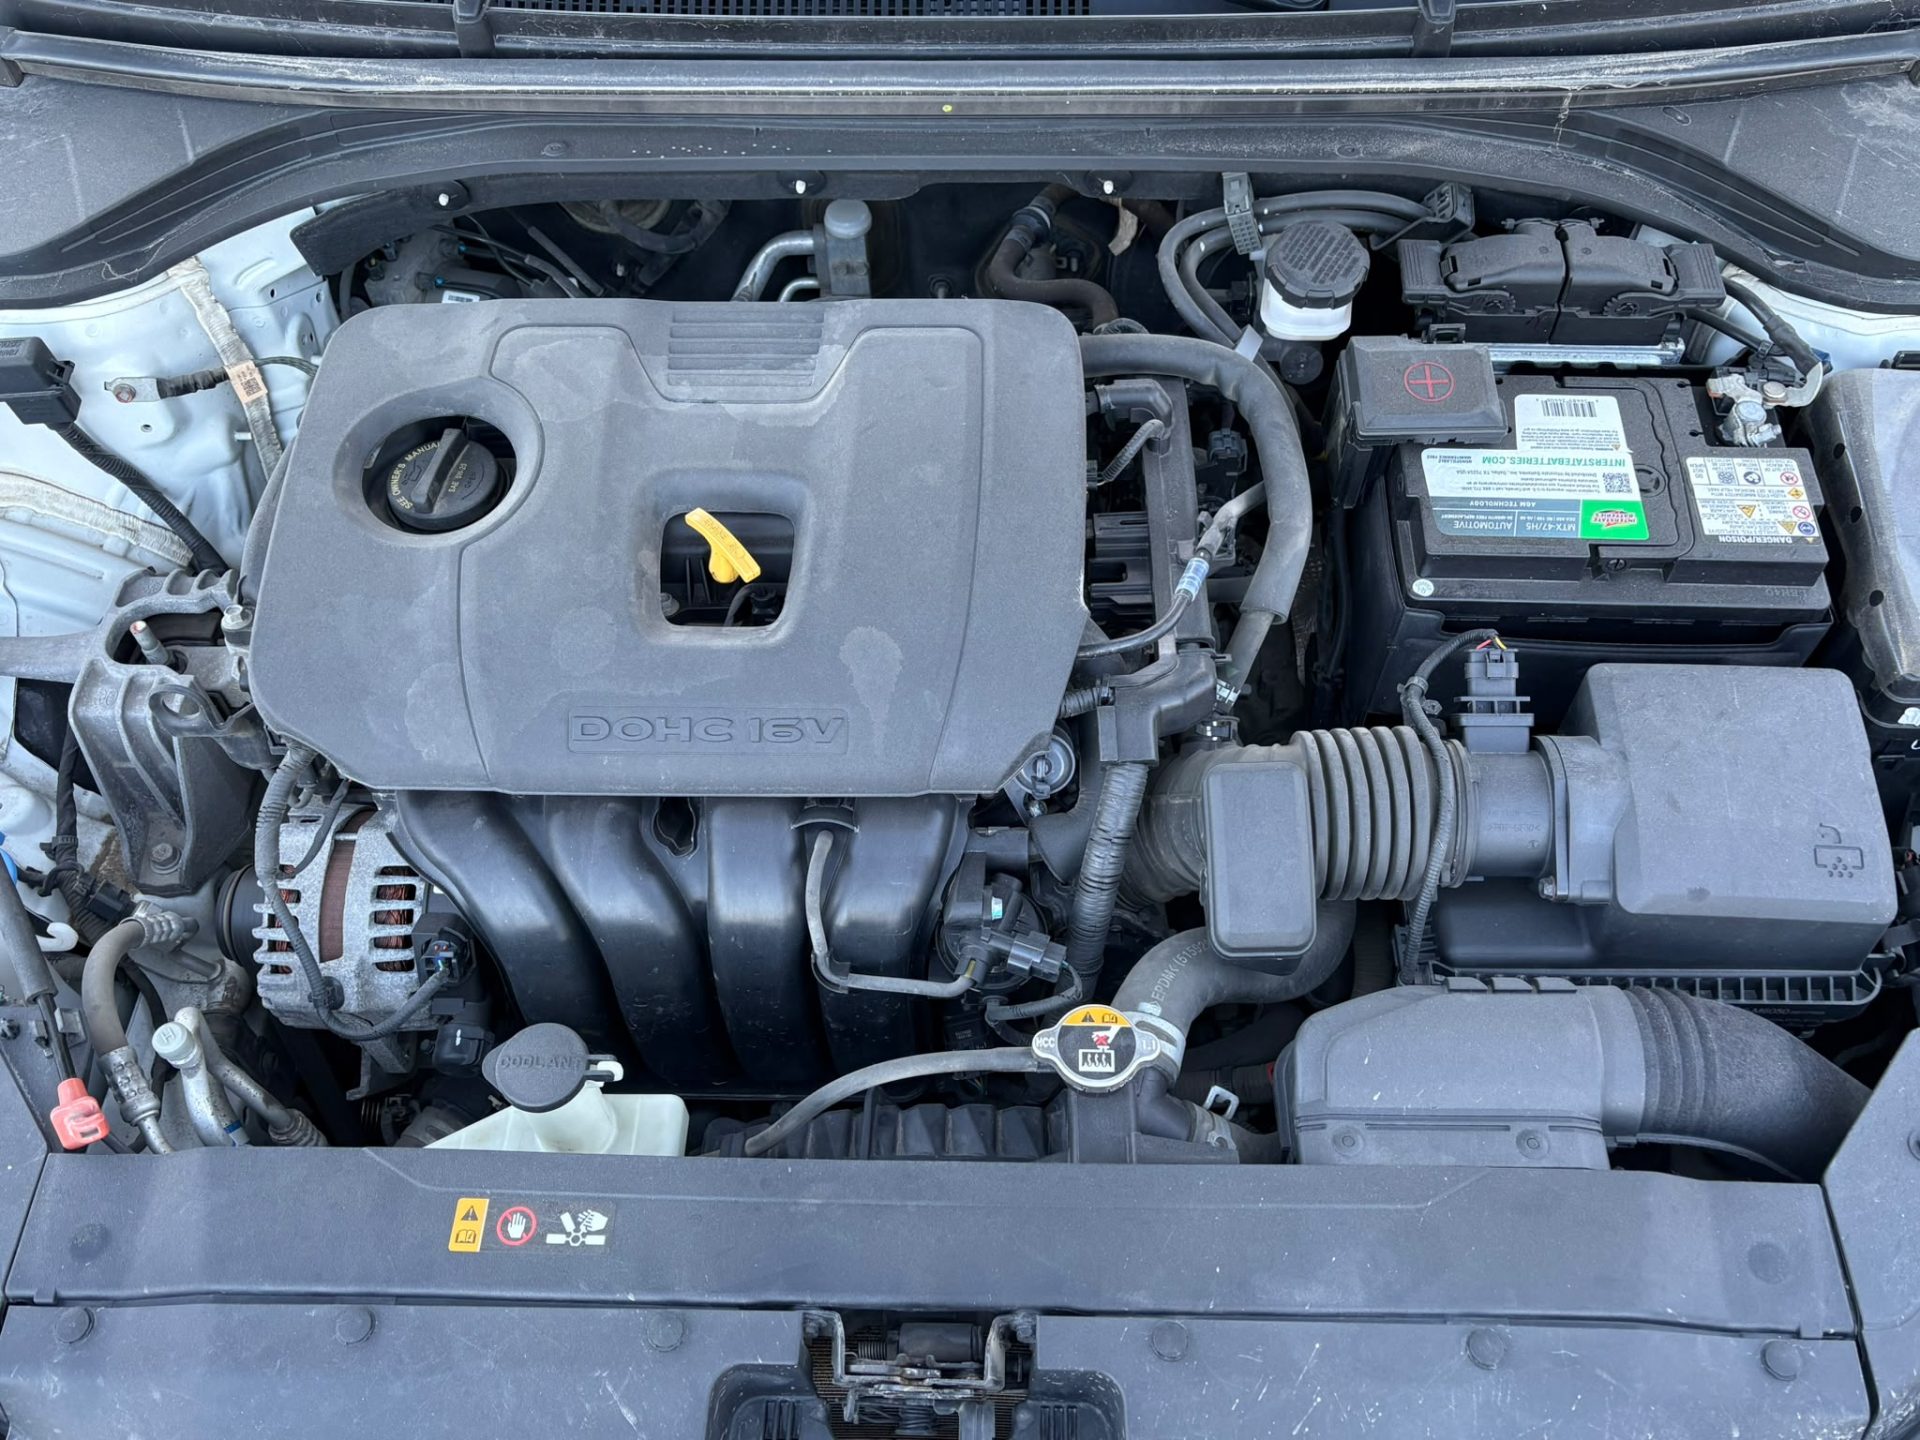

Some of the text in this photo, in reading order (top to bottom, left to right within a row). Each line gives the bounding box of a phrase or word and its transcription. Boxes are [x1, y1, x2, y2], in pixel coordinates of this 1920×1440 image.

[1482, 456, 1626, 467] INTERSTATEBATTERIES.COM
[390, 463, 406, 496] OWNER'S
[396, 496, 413, 510] SEE
[1453, 520, 1512, 530] AUTOMOTIVE
[1526, 522, 1576, 531] MTX-47/H5
[1718, 535, 1793, 544] DANGER/POISON
[572, 716, 845, 744] DOHC 16V
[159, 1027, 177, 1045] H
[1036, 1036, 1156, 1050] HCC 1.1
[501, 1055, 582, 1071] COOLANT
